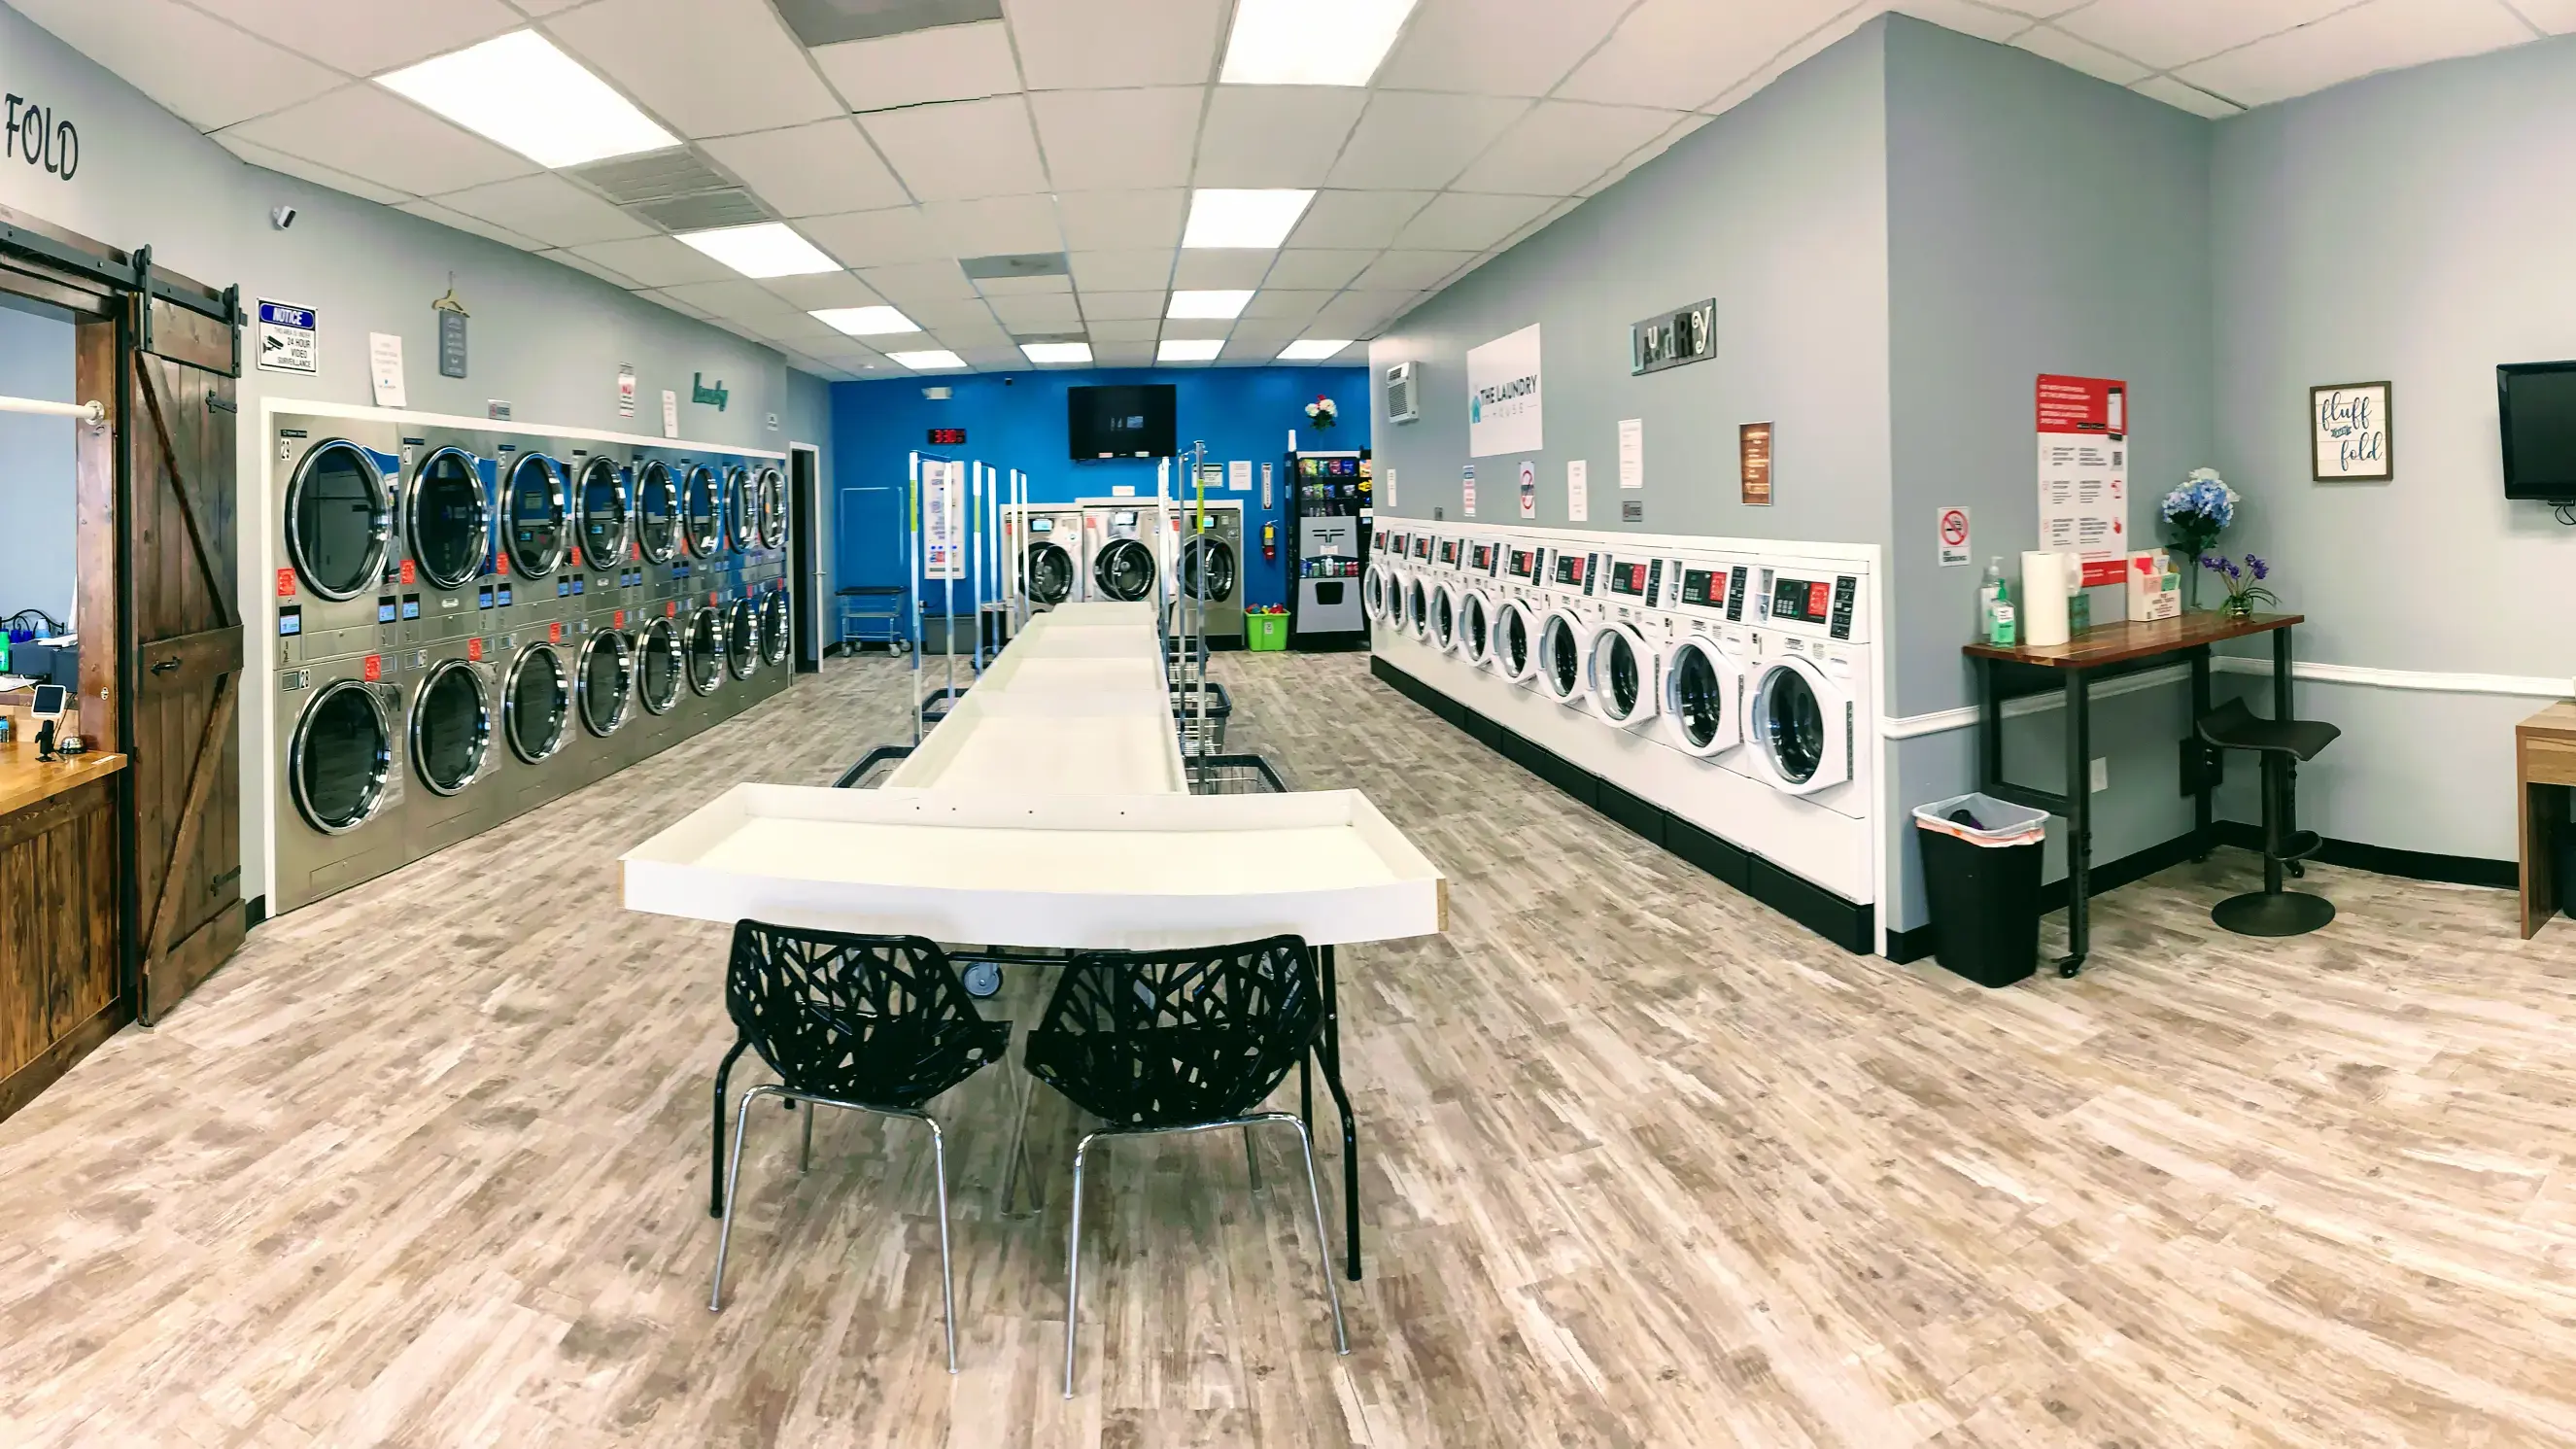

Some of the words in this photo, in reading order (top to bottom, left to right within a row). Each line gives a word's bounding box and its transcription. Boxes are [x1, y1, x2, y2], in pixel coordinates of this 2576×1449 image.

[5, 93, 79, 181] FOLD
[273, 307, 303, 326] NOTICE
[287, 336, 294, 346] 24
[295, 338, 311, 348] HOUR
[291, 348, 308, 359] VIDEO
[277, 356, 311, 368] SURVEILLANCE
[1480, 387, 1495, 406] THE
[1496, 374, 1537, 402] LAUNDRY
[2321, 391, 2373, 431] fluff
[2341, 431, 2384, 471] fold
